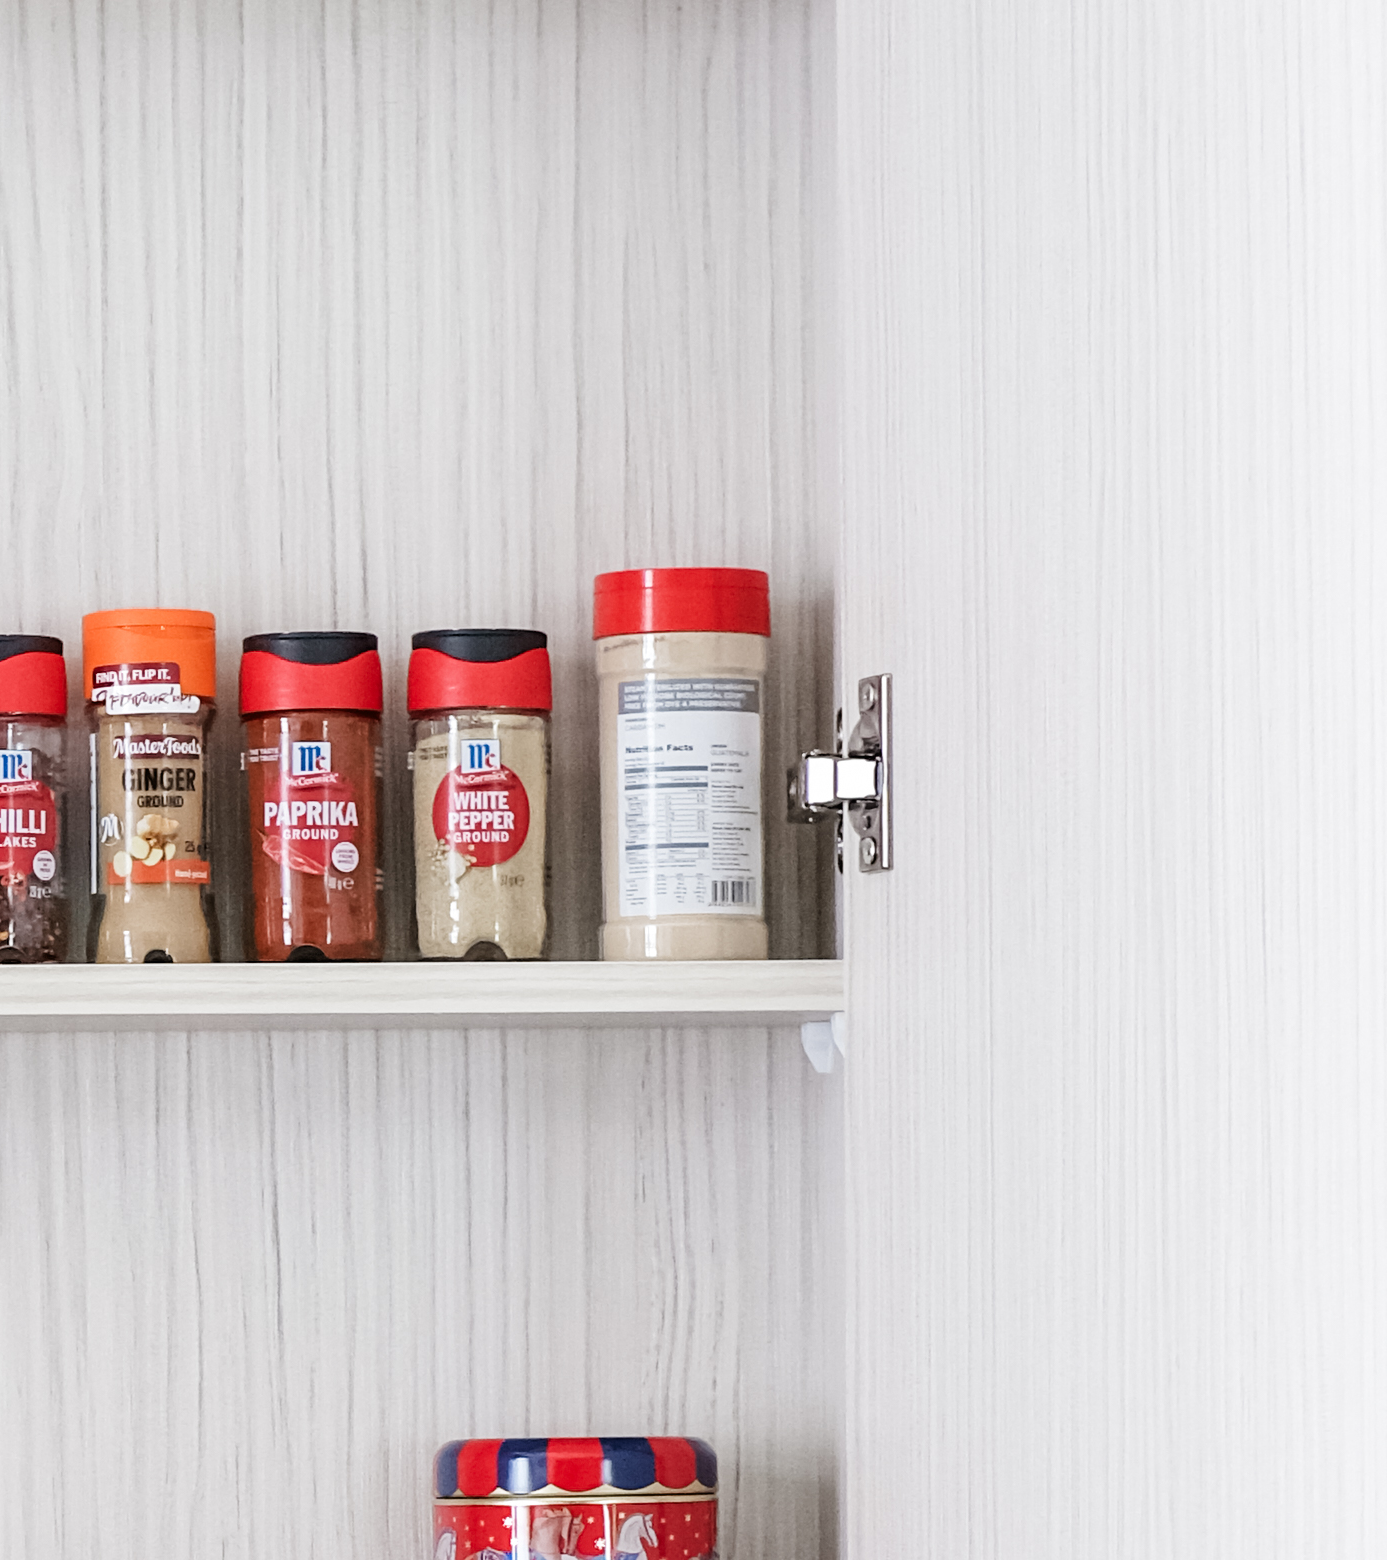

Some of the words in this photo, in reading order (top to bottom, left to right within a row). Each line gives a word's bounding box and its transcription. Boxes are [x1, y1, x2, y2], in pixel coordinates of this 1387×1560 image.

[95, 671, 117, 684] FIND
[132, 669, 157, 680] FLIP
[158, 668, 171, 680] IT.
[113, 736, 202, 758] MasterFoods
[122, 767, 196, 792] GINGER
[137, 795, 184, 808] GROUND
[453, 791, 509, 810] WHITE
[263, 801, 359, 827] PAPRIKA
[448, 811, 515, 831] PEPPER
[283, 828, 339, 840] GROUND
[453, 831, 509, 842] GROUND
